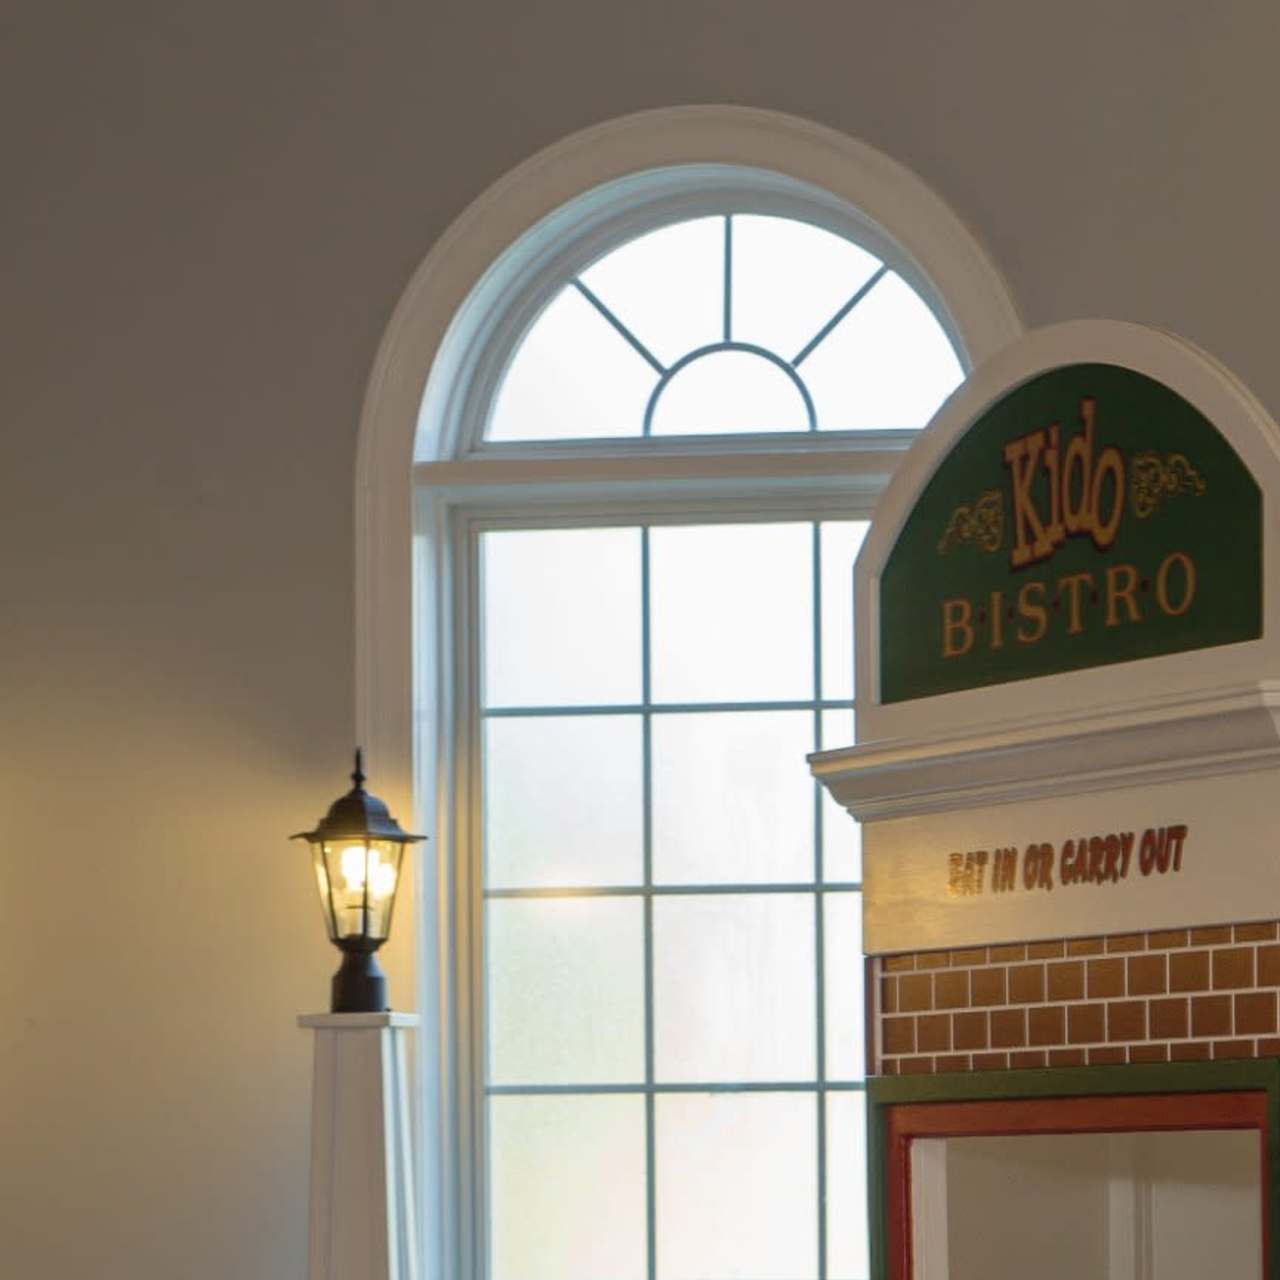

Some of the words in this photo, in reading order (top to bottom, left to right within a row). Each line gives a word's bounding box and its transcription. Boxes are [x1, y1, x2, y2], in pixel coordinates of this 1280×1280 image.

[1003, 396, 1126, 573] Kido
[948, 851, 988, 896] EAT
[992, 847, 1018, 892] IN
[1024, 842, 1055, 891] OR
[1060, 832, 1135, 886] CARRY
[1139, 825, 1188, 876] OUT
